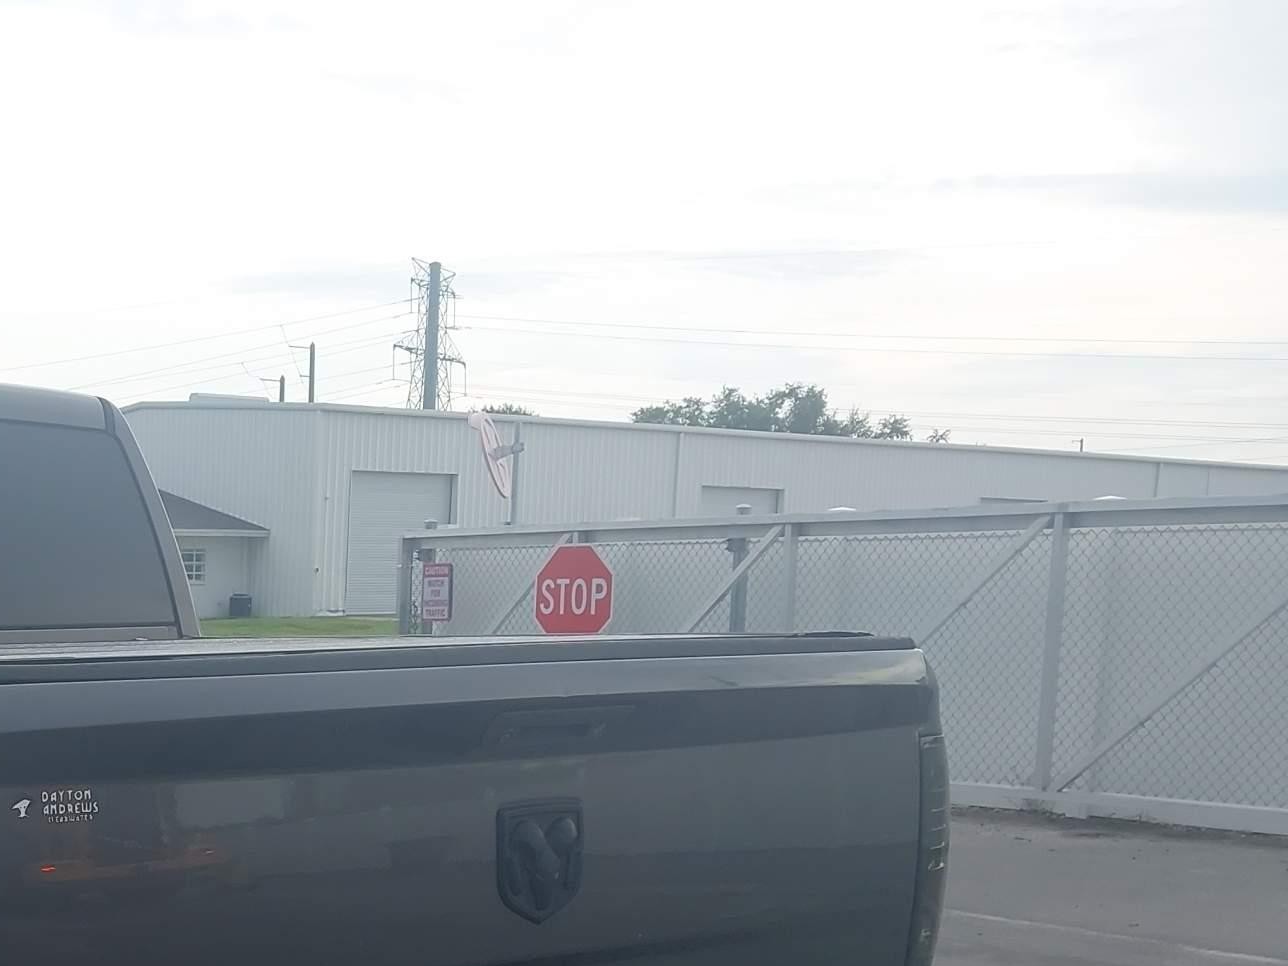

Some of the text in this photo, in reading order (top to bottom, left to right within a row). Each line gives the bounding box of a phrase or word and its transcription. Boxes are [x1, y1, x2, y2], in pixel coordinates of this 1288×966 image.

[539, 578, 608, 615] STOP
[41, 789, 91, 802] DAYTON
[43, 802, 98, 814] ANDREWS
